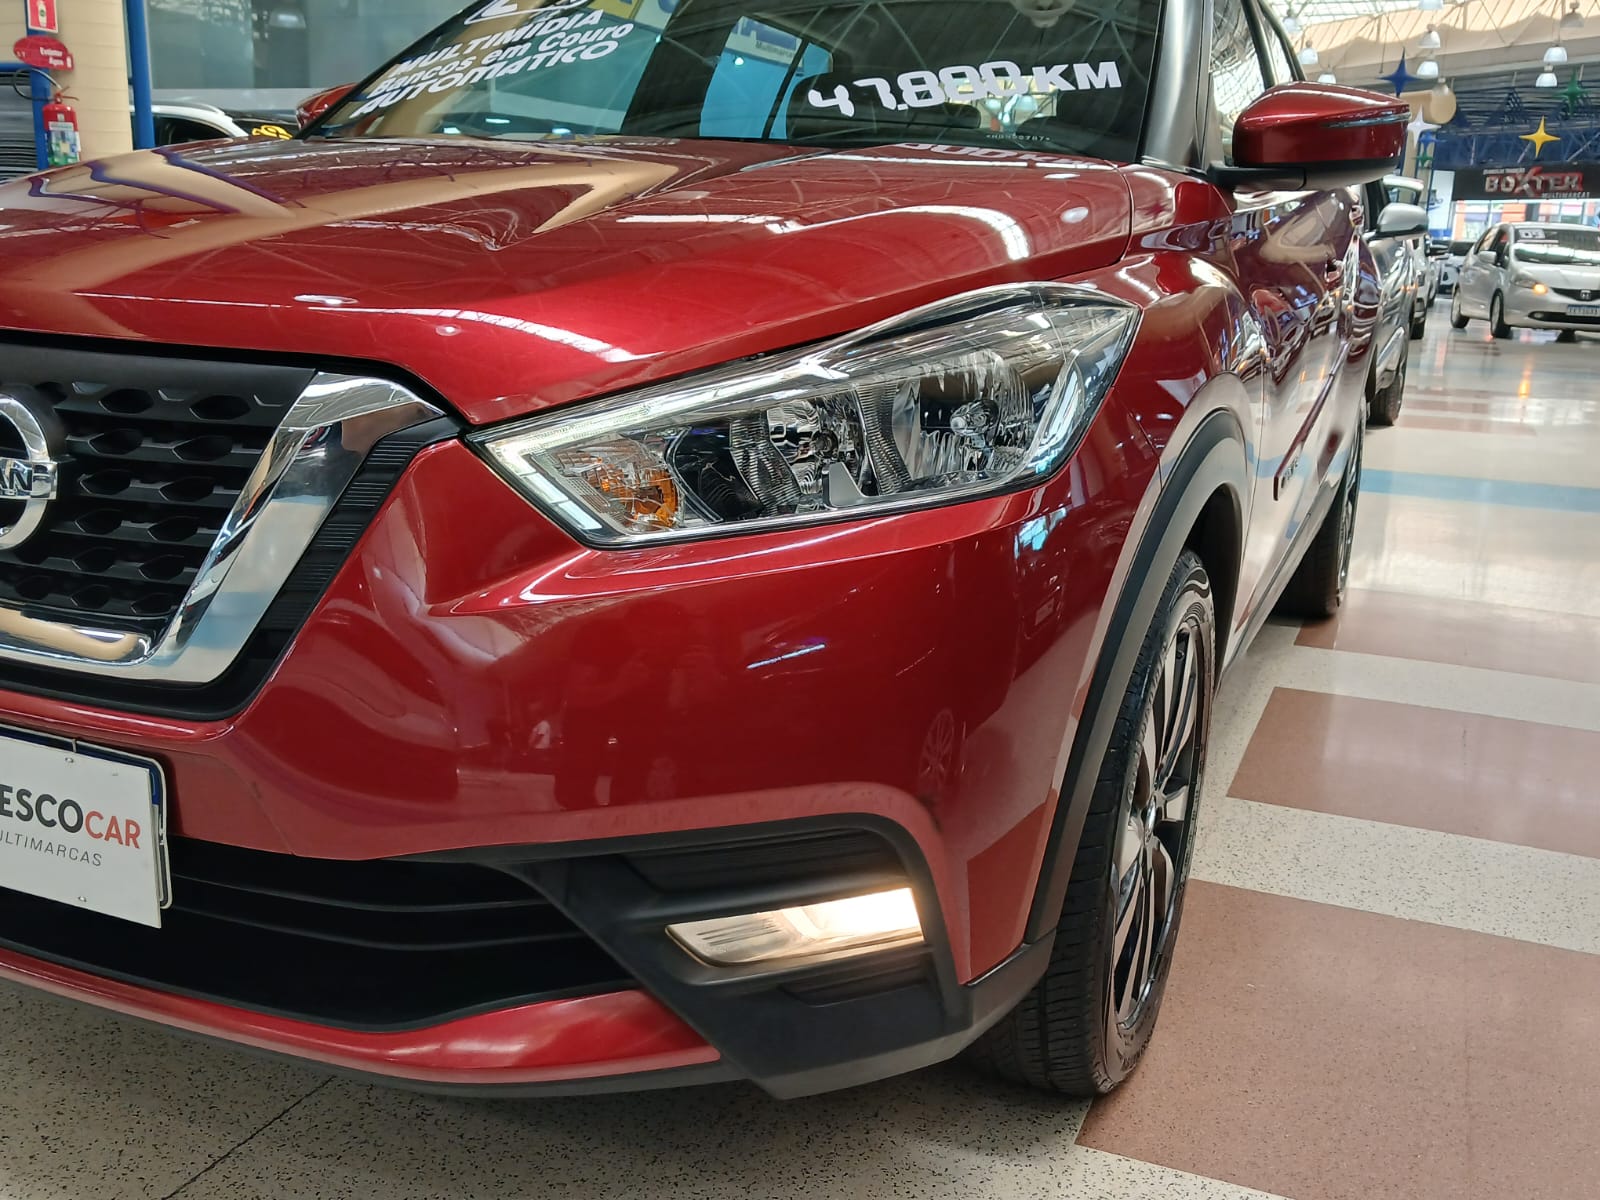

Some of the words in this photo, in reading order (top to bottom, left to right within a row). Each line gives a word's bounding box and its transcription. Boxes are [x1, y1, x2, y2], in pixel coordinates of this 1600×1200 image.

[367, 55, 477, 98] Bancos
[482, 43, 532, 63] em
[538, 24, 634, 52] Couro
[0, 784, 141, 849] ESCOCAR
